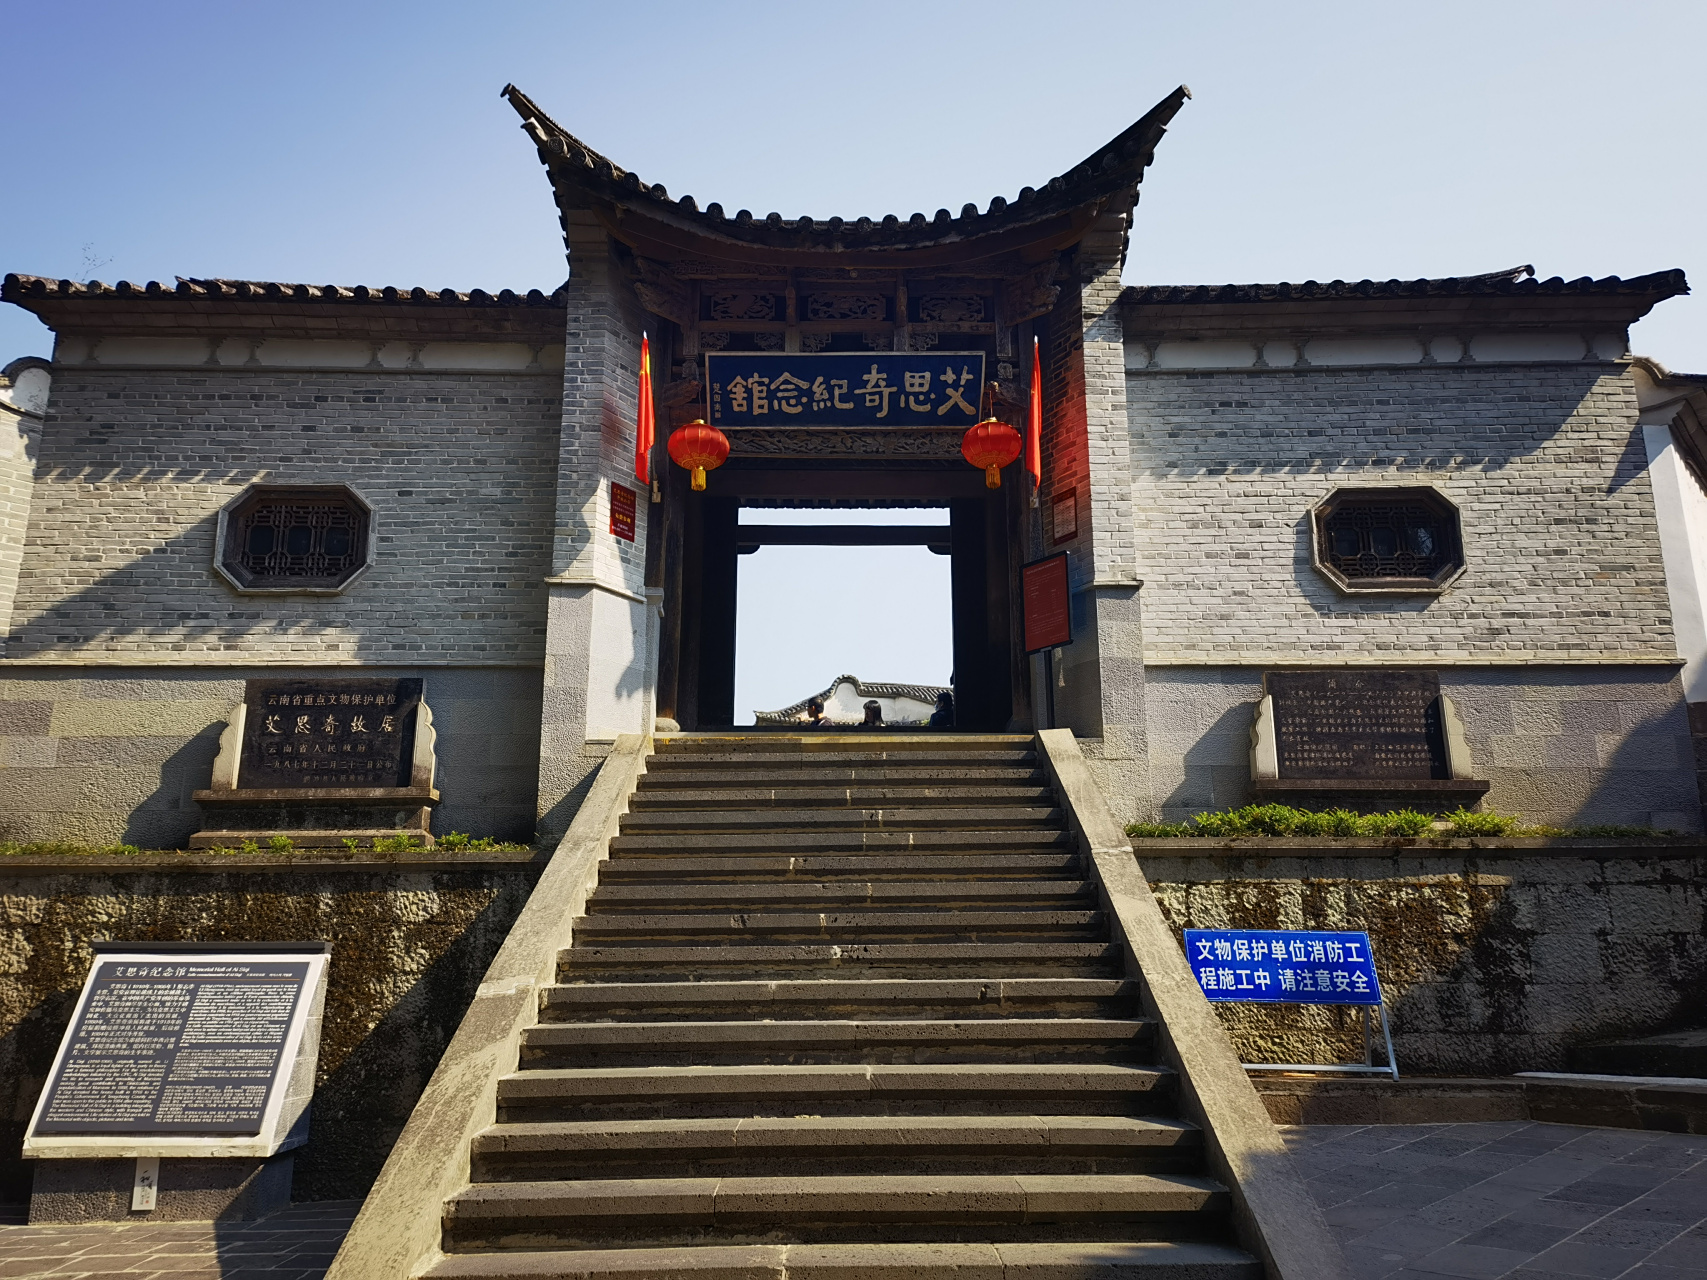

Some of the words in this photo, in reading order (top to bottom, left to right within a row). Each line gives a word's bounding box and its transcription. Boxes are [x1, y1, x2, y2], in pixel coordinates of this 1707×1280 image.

[268, 694, 397, 706] 云南省重点文物保护单位
[265, 714, 395, 735] 艾思奇故居
[268, 744, 366, 753] 云南省人民政府
[264, 761, 392, 769] 一九八七年十二月二十一日公布
[1196, 939, 1365, 963] 文物保护单位消防工
[113, 966, 187, 977] 艾思奇纪念馆
[1200, 967, 1271, 991] 程施工中
[1279, 969, 1371, 993] 请注意安全
